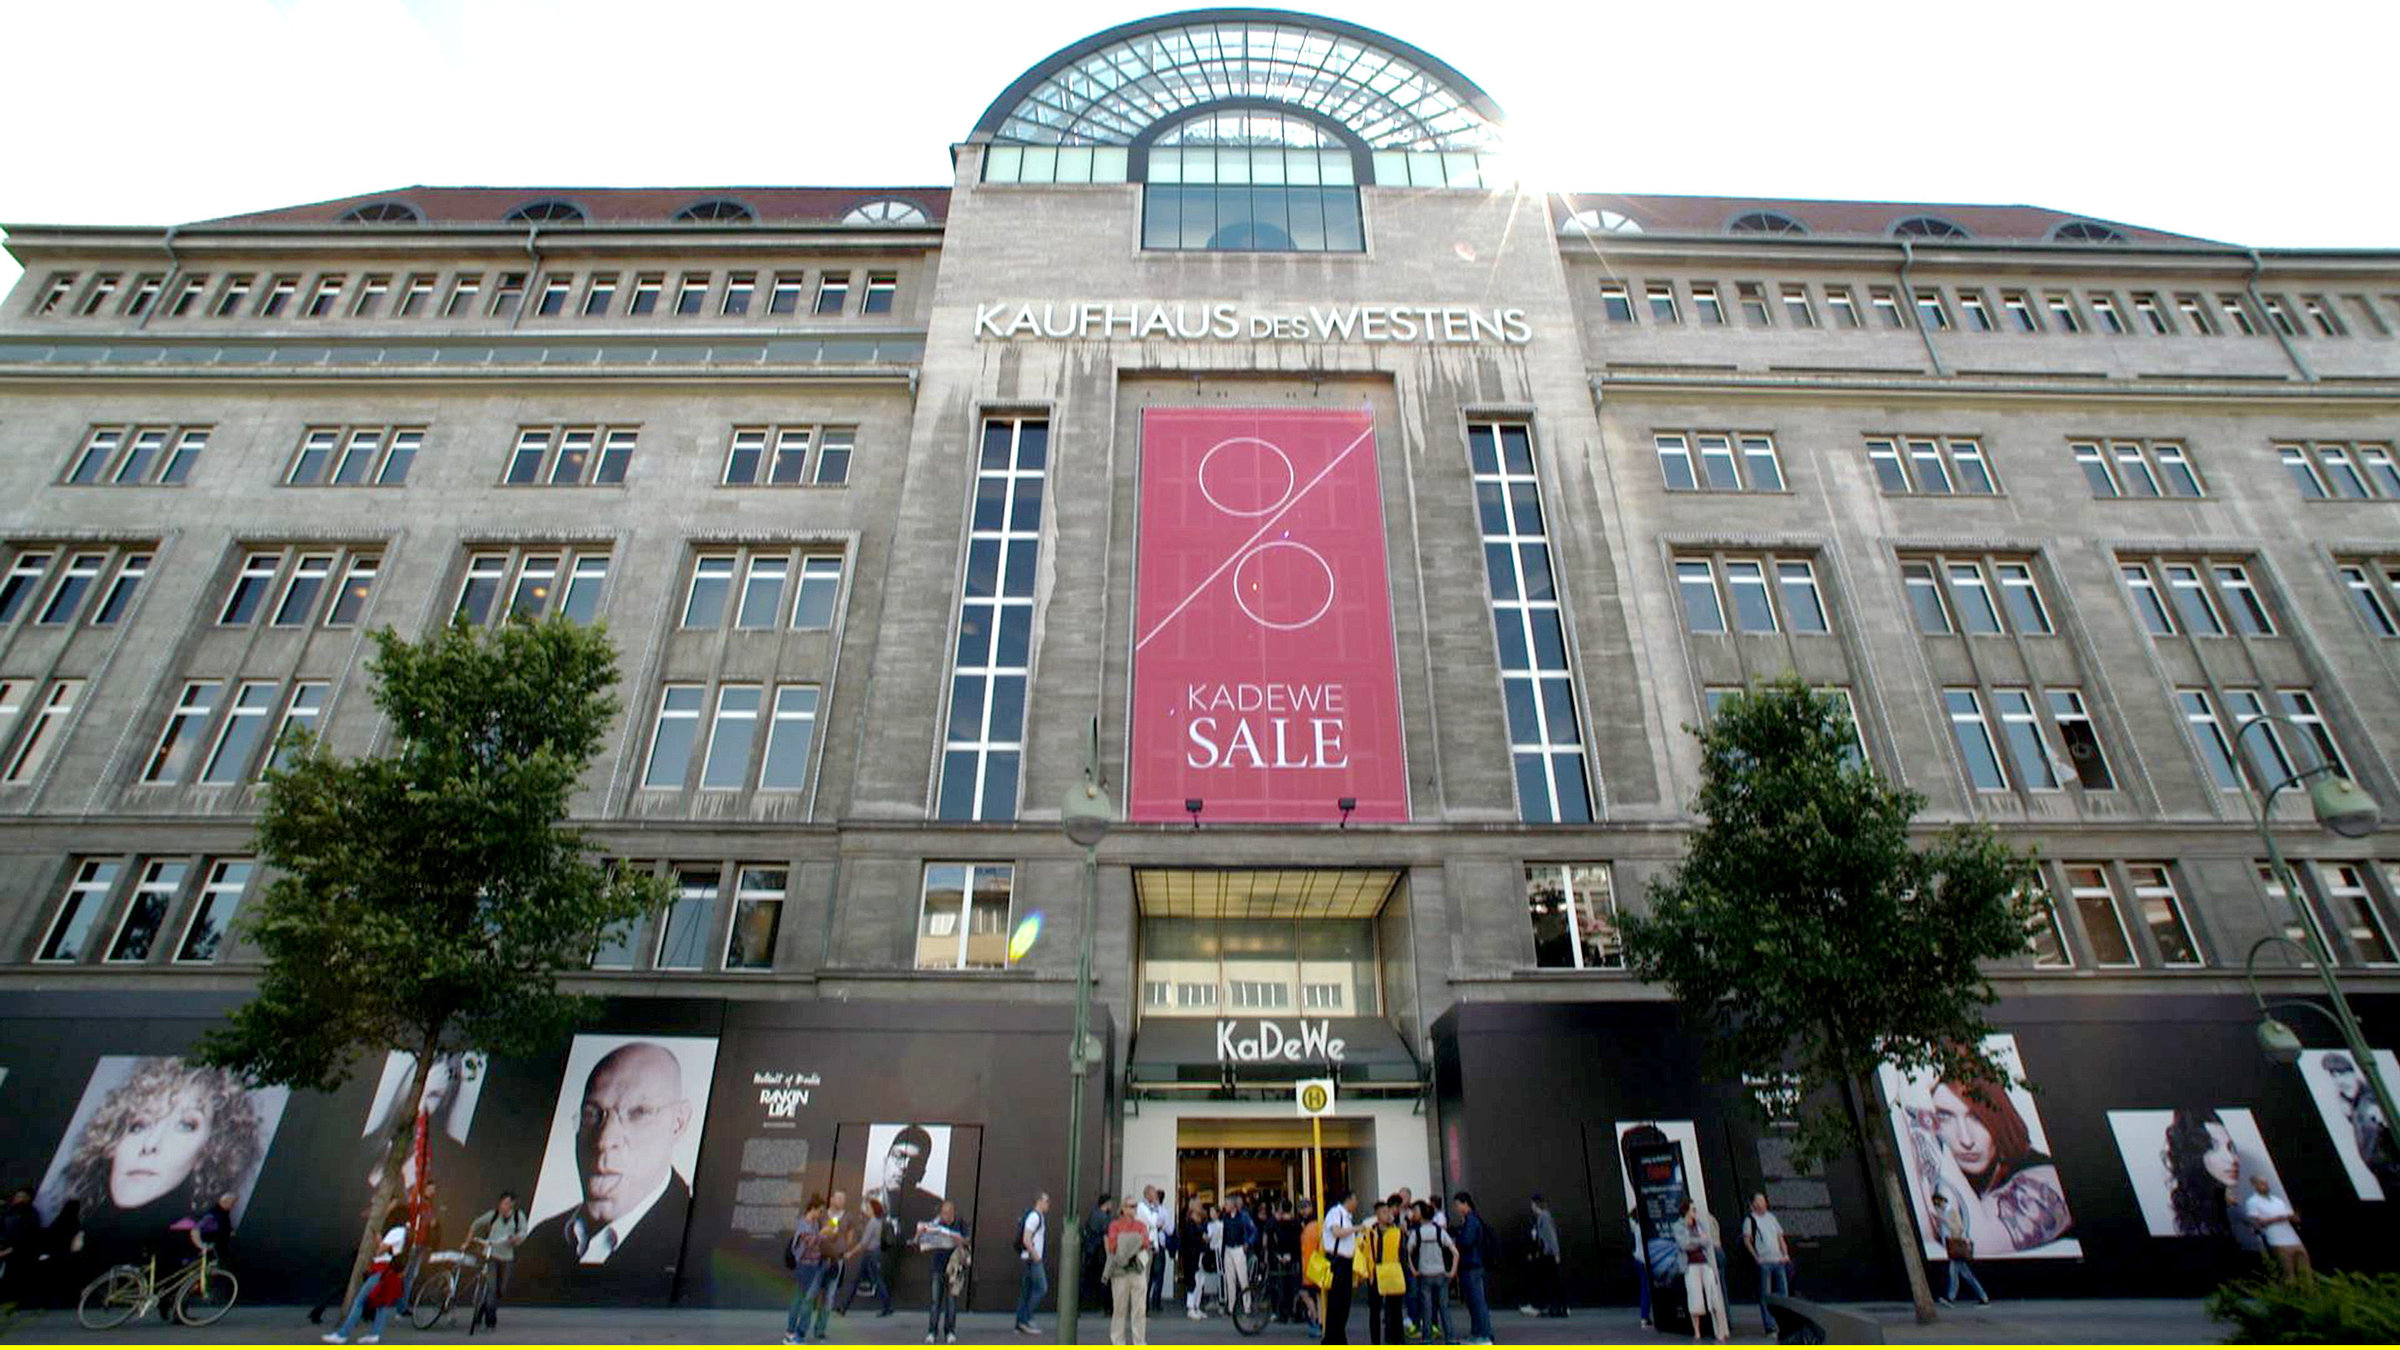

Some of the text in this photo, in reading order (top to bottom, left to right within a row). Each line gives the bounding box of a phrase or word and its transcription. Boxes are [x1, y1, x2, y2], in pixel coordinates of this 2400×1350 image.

[974, 303, 1533, 343] KAUFHAUS DES WESTENS
[1187, 683, 1345, 712] KADEWE
[1186, 716, 1349, 769] SALE
[1216, 1018, 1346, 1062] KaDeWe
[1308, 1091, 1322, 1107] H
